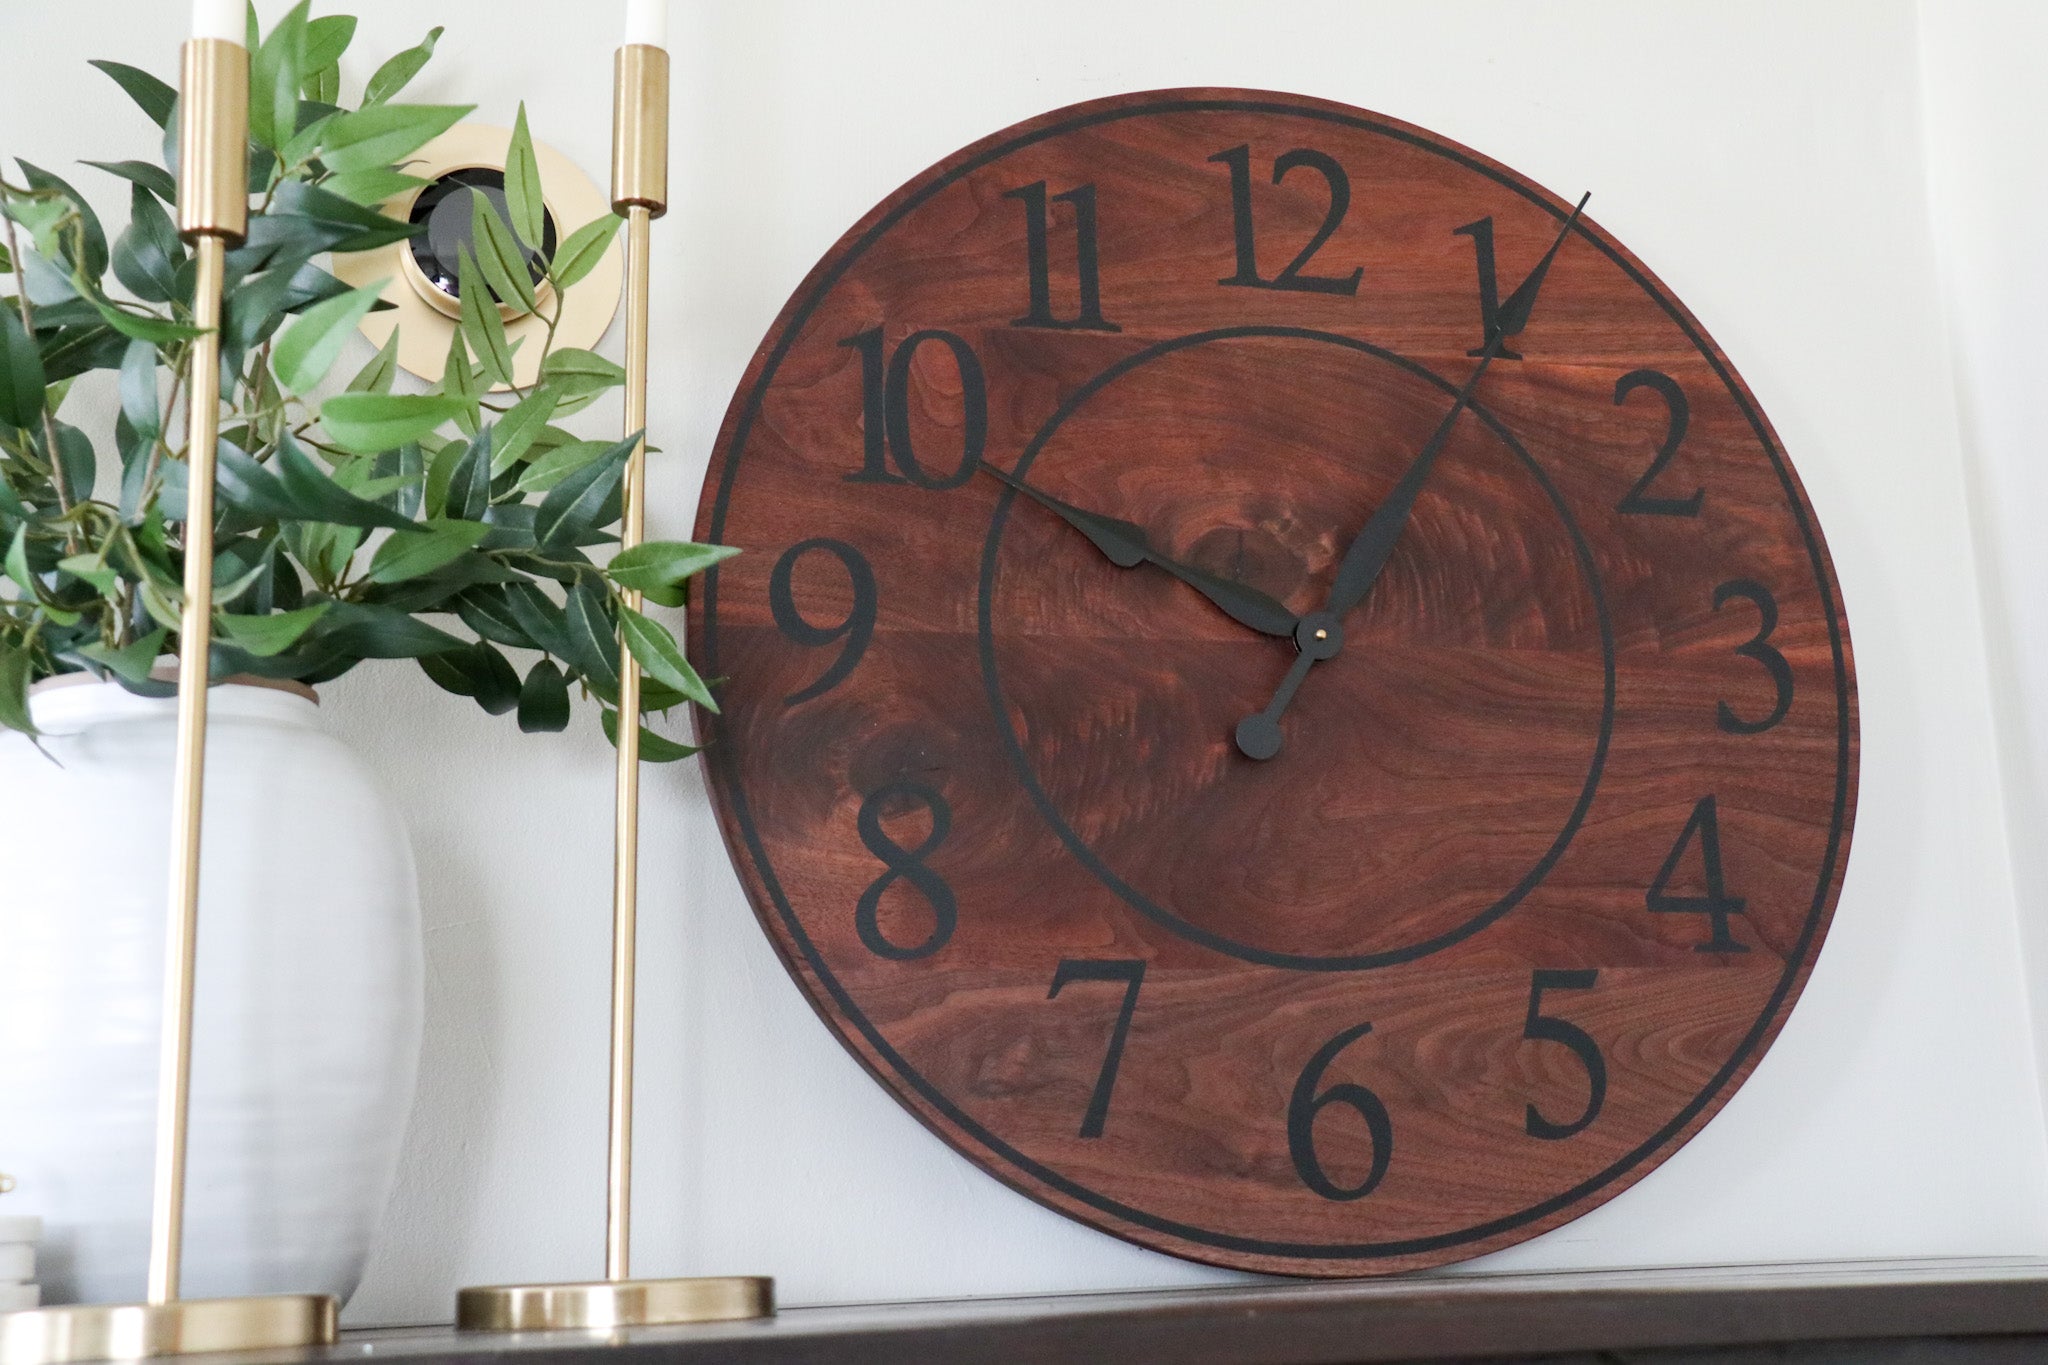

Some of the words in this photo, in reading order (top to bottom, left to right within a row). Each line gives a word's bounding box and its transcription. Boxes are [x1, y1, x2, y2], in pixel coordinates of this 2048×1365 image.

[1002, 180, 1122, 333] 11
[1207, 143, 1364, 296] 12
[1452, 216, 1523, 361] 1
[837, 326, 988, 490] 10
[1613, 369, 1706, 518] 2
[769, 537, 878, 708] 9
[1712, 576, 1795, 735] 3
[855, 782, 958, 961] 8
[1645, 794, 1751, 956] 4
[1048, 959, 1147, 1139] 7
[1287, 1021, 1393, 1202] 6
[1523, 968, 1608, 1141] 5
